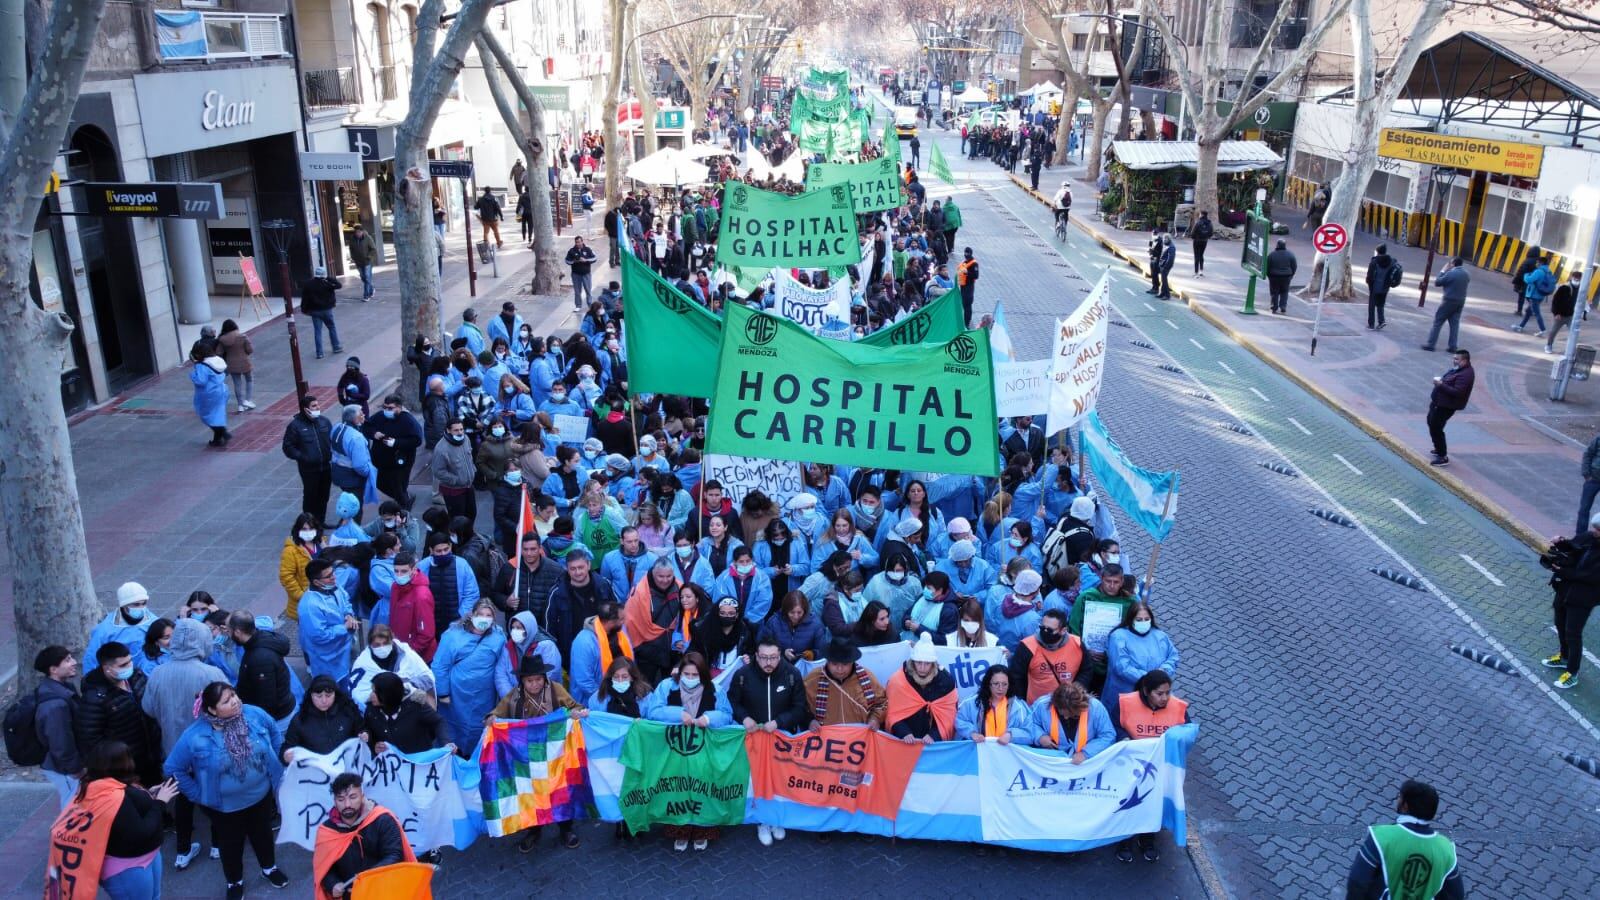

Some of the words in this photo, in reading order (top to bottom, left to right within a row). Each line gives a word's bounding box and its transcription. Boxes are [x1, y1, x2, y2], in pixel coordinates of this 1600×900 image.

[201, 90, 255, 130] Etam
[1386, 131, 1501, 156] Estacionamiento
[728, 215, 848, 237] HOSPITAL
[732, 237, 846, 258] GAILHAC
[738, 348, 777, 358] MENDOZA
[943, 365, 980, 376] MENDOZA
[738, 370, 973, 420] HOSPITAL
[734, 408, 972, 457] CARRILLO
[787, 775, 823, 793] Santa
[828, 784, 858, 799] Rosa
